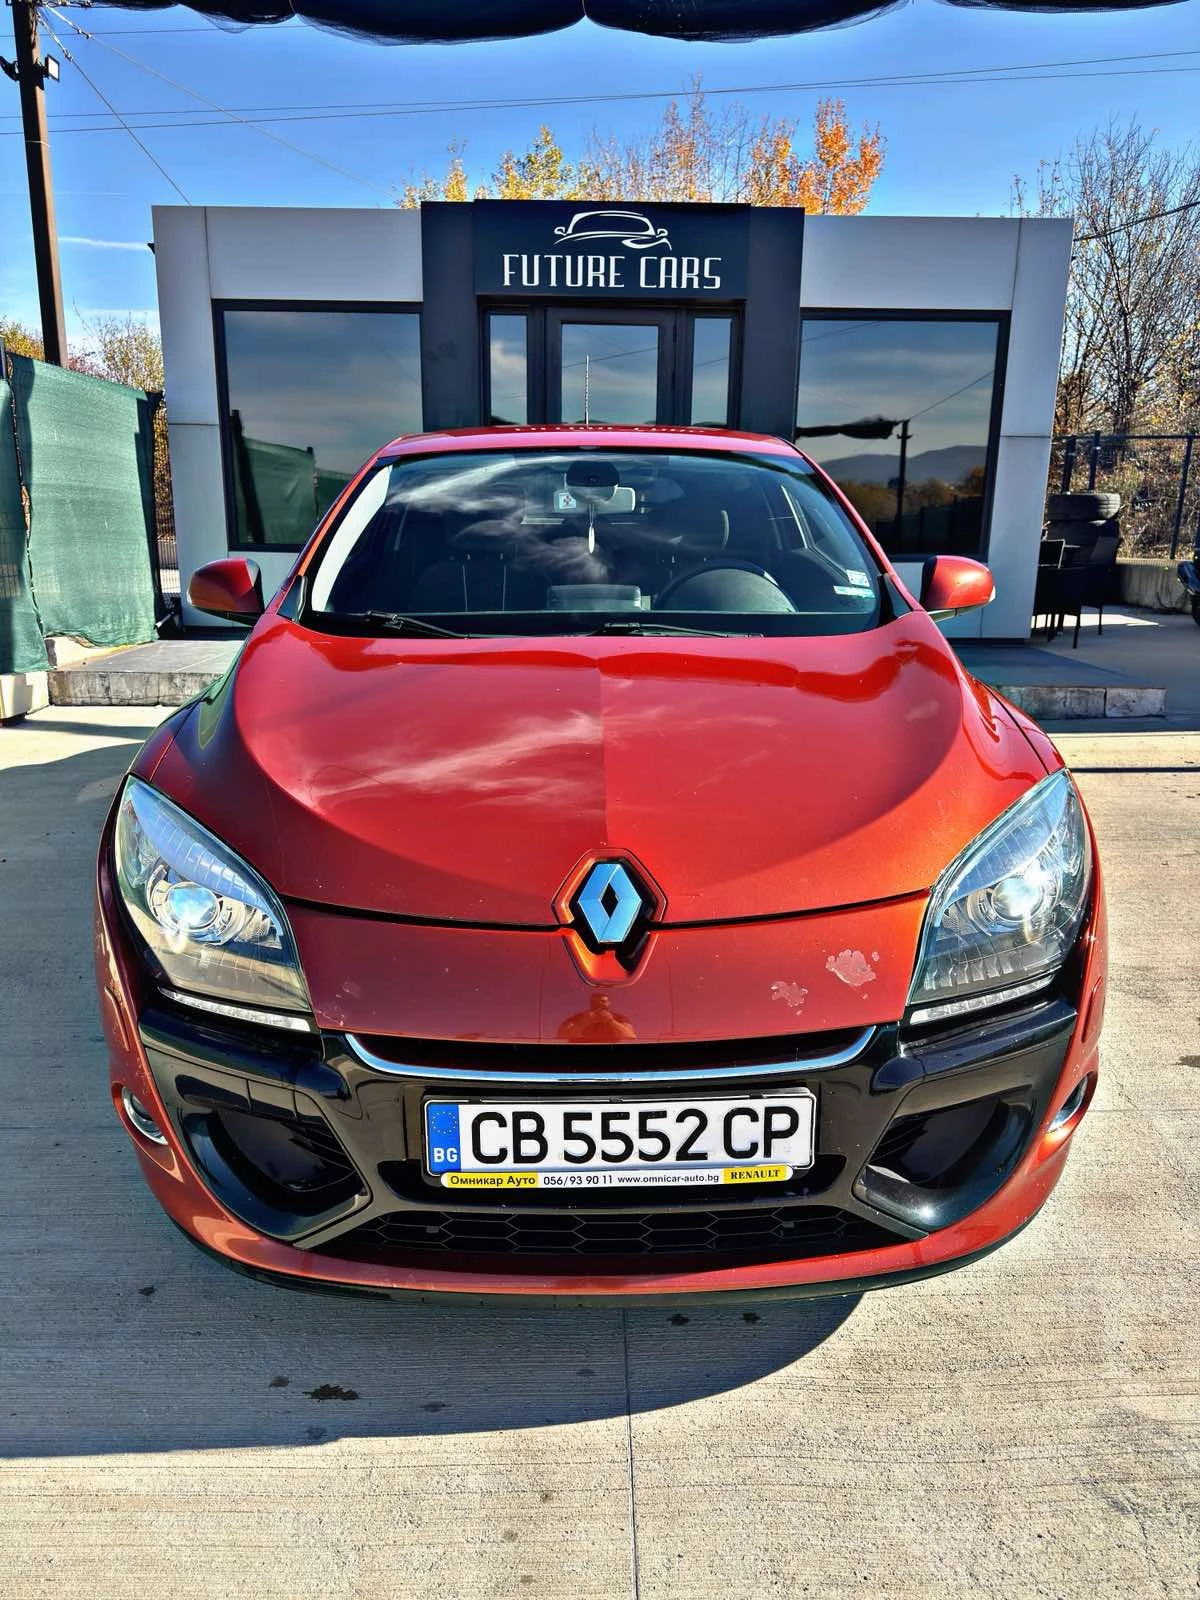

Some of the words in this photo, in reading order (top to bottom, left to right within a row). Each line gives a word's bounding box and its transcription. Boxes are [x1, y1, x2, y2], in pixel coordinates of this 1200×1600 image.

[503, 254, 625, 287] FUTURE
[640, 256, 721, 289] CARS
[471, 1111, 548, 1164] CB
[563, 1108, 708, 1164] 5552
[723, 1106, 799, 1160] CP
[433, 1147, 458, 1163] BG
[450, 1175, 503, 1187] Омникар
[506, 1175, 536, 1187] Ауто
[543, 1175, 583, 1187] 056/93
[586, 1175, 599, 1186] 90
[603, 1174, 613, 1185] 11
[617, 1174, 720, 1184] www.omnicar-auto.bg
[730, 1169, 781, 1181] RENAULT
